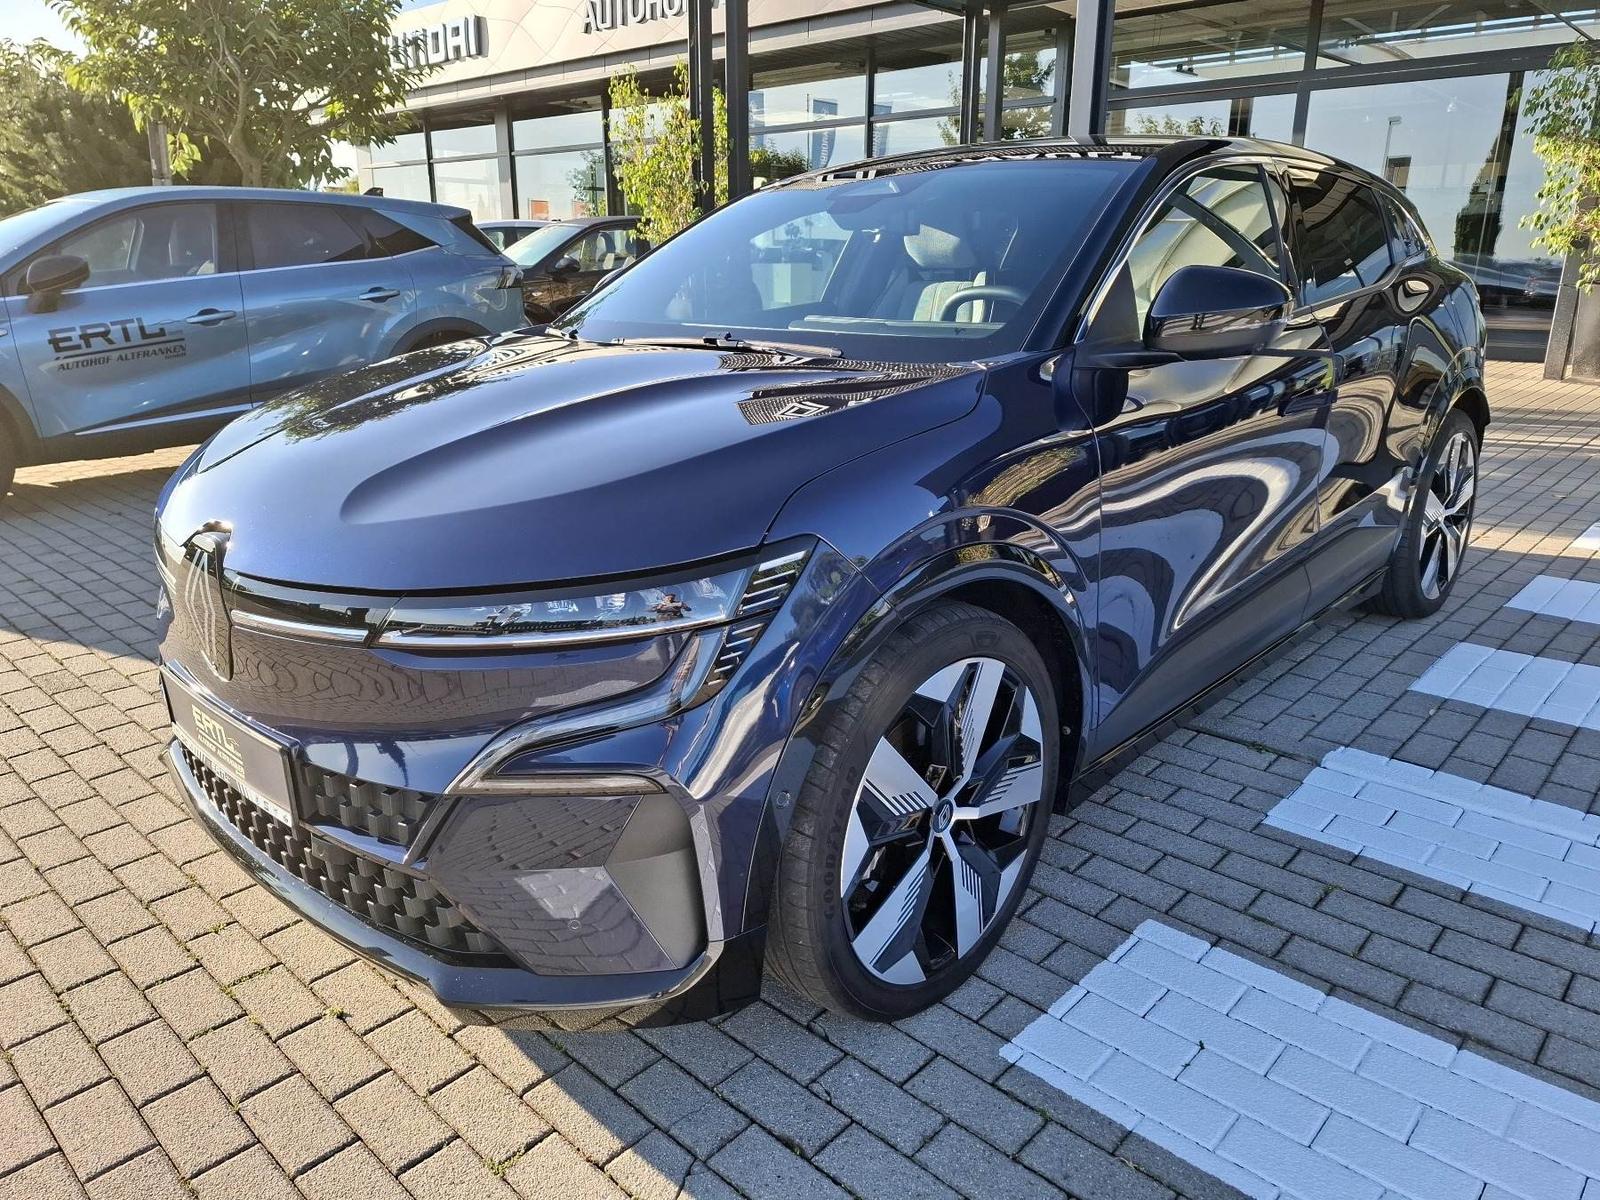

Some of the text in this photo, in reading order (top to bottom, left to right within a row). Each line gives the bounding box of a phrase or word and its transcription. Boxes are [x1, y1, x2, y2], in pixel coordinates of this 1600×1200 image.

[581, 0, 688, 34] AUTOHO
[47, 316, 167, 353] ERTL
[57, 356, 114, 372] AUTOHOF
[116, 344, 188, 362] ALTFRANKEN
[191, 703, 235, 752] ERTL
